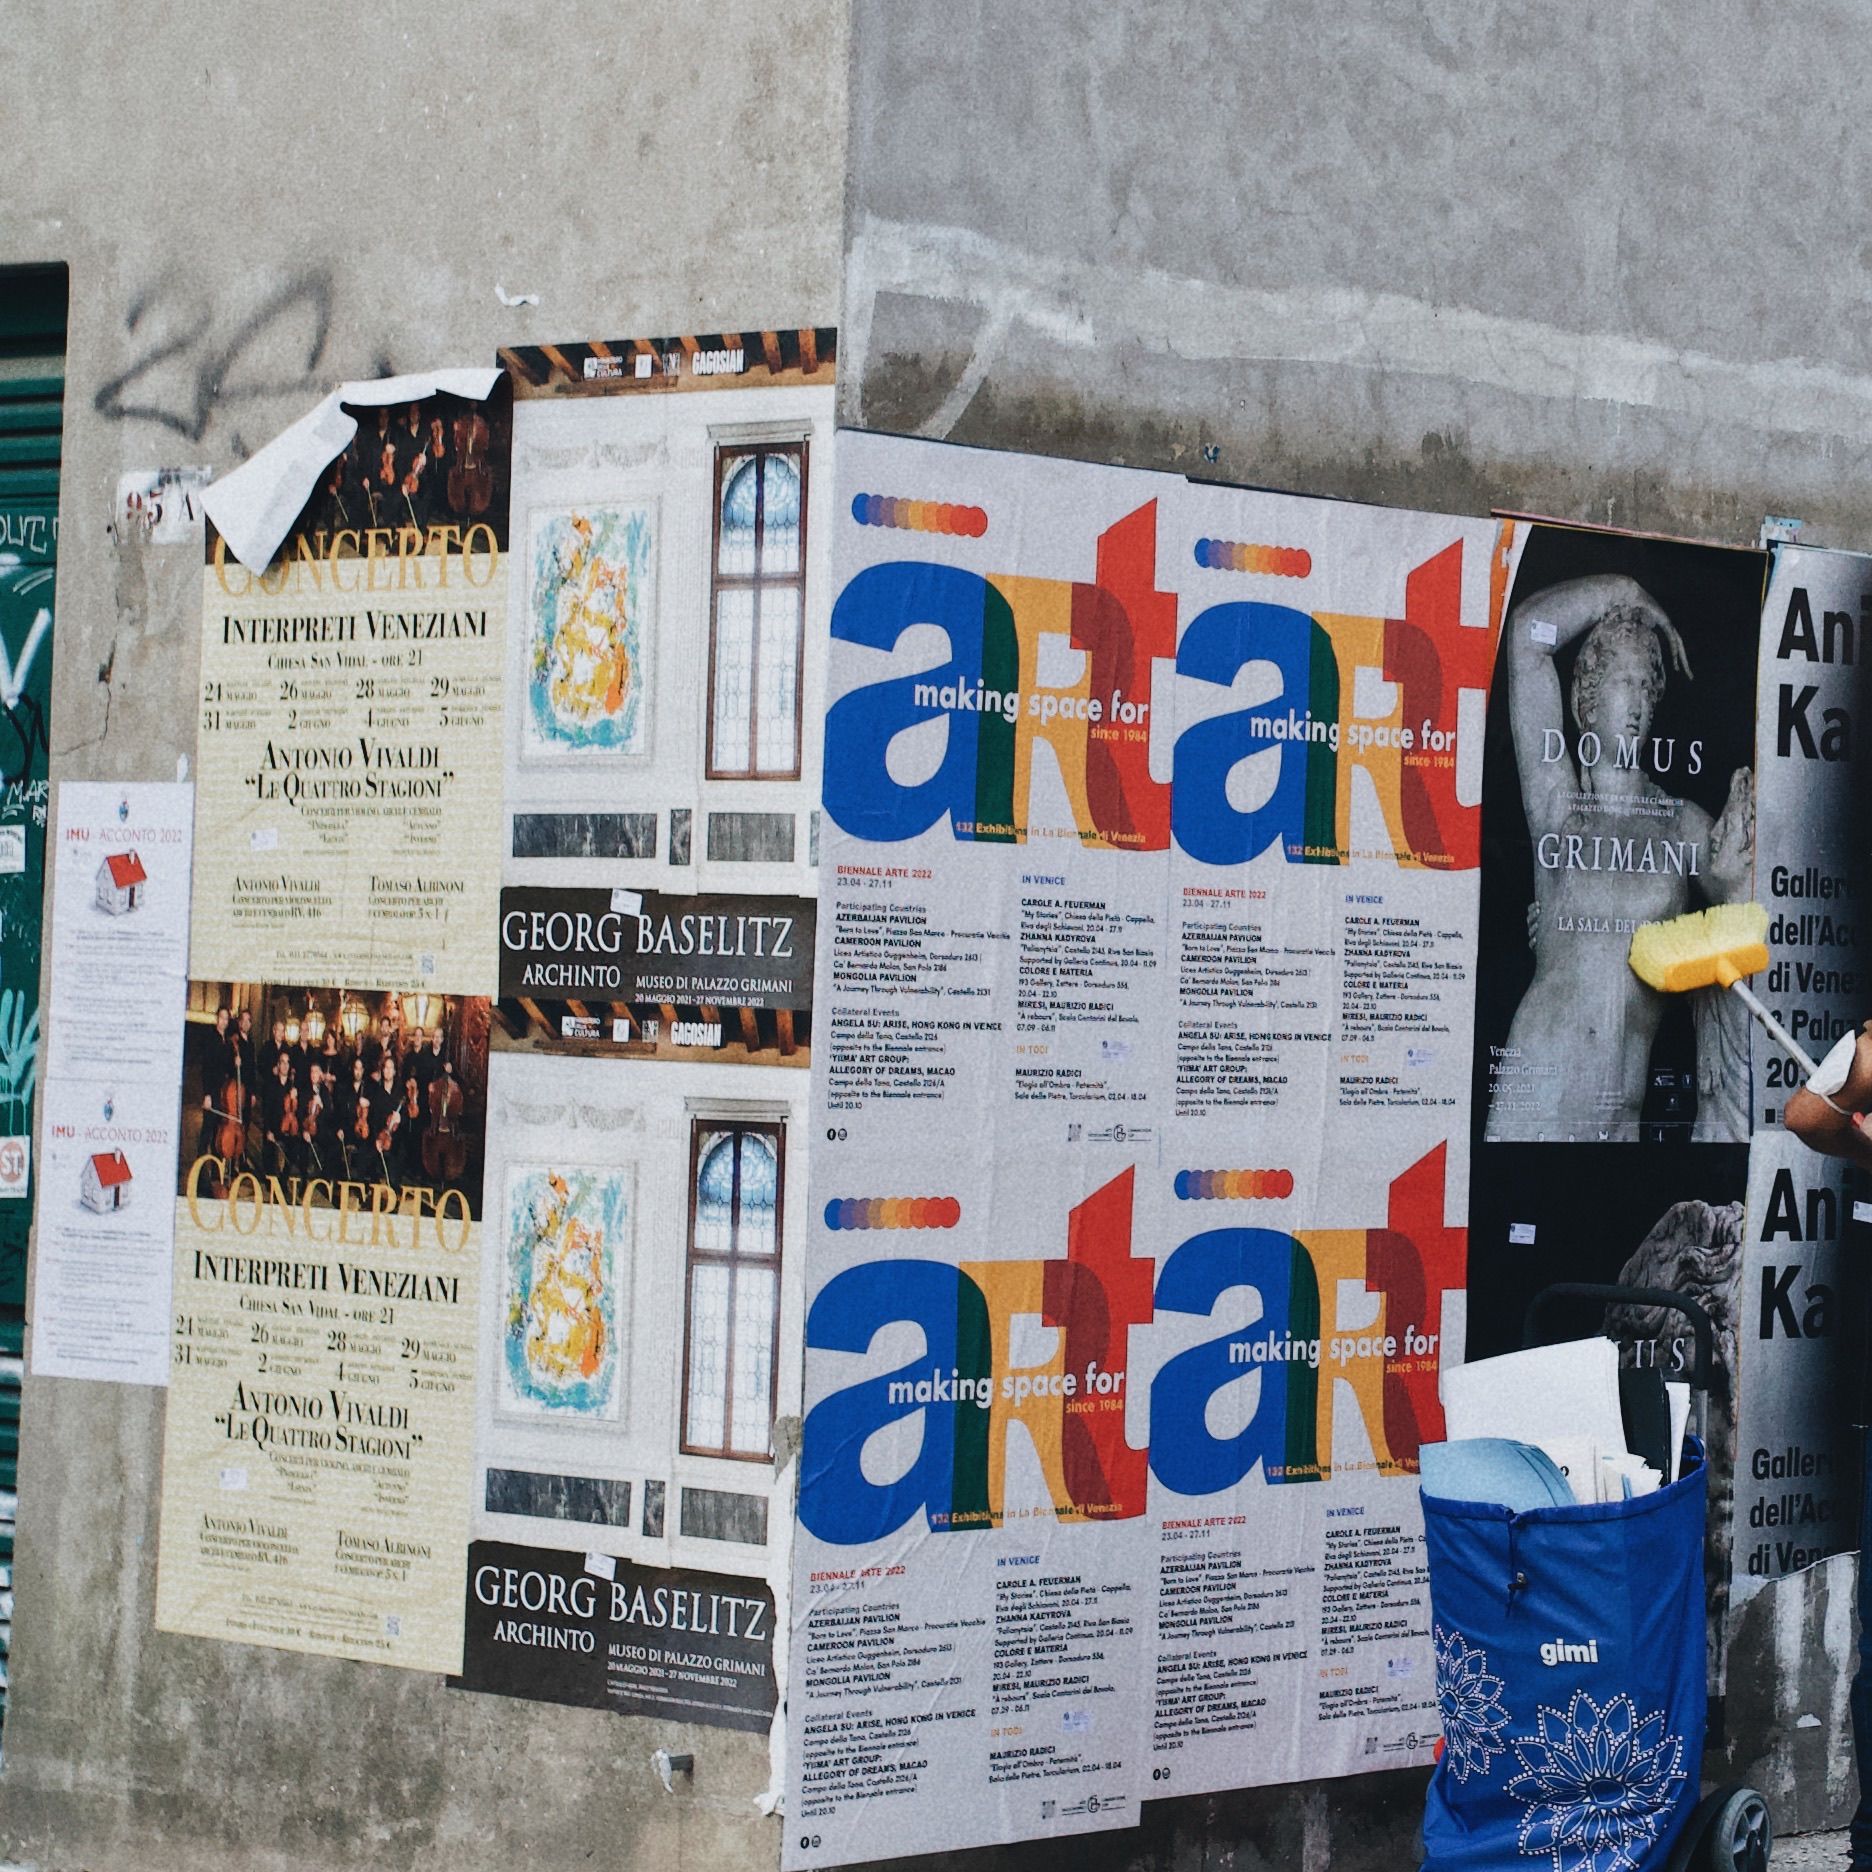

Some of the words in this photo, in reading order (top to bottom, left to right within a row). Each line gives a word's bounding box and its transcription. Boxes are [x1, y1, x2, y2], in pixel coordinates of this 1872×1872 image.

[692, 349, 744, 375] GAGOSIAN
[224, 616, 355, 643] INTERPRETI
[367, 611, 486, 639] VENEZIANI
[268, 654, 305, 670] CHIESA
[311, 654, 331, 668] SAN
[408, 649, 423, 666] 21
[279, 681, 298, 701] 26
[356, 679, 375, 699] 28
[430, 677, 449, 697] 29
[915, 676, 1019, 723] making
[1028, 695, 1102, 725] space
[1111, 689, 1148, 724] for
[204, 711, 220, 730] 31
[1251, 709, 1339, 752] making
[1348, 724, 1413, 754] space
[1421, 720, 1455, 751] for
[1123, 730, 1146, 742] 1984
[261, 740, 352, 770] ANTONIO
[359, 737, 439, 768] VIVALDI
[1434, 756, 1454, 768] 1984
[1541, 728, 1703, 775] DOMUS
[283, 771, 360, 806] QUATTRO
[66, 830, 90, 841] IMU
[100, 830, 156, 842] ACCONTO
[161, 830, 182, 842] 2022
[1538, 833, 1700, 876] GRIMANI
[234, 876, 278, 892] ANTONIO
[369, 876, 411, 892] TOMASO
[837, 866, 882, 876] BIENNALE
[886, 868, 908, 877] ARTE
[912, 870, 932, 878] 2022
[502, 911, 622, 953] GEORG
[636, 914, 793, 957] BASELITZ
[1558, 917, 1574, 931] LA
[1578, 918, 1610, 932] SALA
[884, 938, 921, 948] PAVILION
[522, 963, 620, 987] ARCHINTO
[636, 976, 673, 989] MUSEO
[676, 977, 688, 989] DI
[692, 977, 738, 991] PALAZZO
[741, 979, 792, 993] GRIMANI
[880, 973, 917, 982] PAVILION
[1769, 962, 1790, 993] di
[671, 1021, 721, 1046] GAGOSIAN
[52, 1126, 75, 1138] IMU
[84, 1128, 141, 1142] ACCONTO
[146, 1131, 168, 1143] 2022
[187, 1154, 471, 1253] CONCERTO
[195, 1250, 327, 1291] INTERPRETI
[338, 1263, 459, 1303] VENEZIANI
[240, 1297, 277, 1313] CHIESA
[282, 1298, 303, 1315] SAN
[380, 1308, 394, 1324] 21
[1229, 1330, 1321, 1368] making
[1330, 1333, 1397, 1367] space
[1404, 1326, 1438, 1356] for
[1416, 1360, 1436, 1372] 1984
[888, 1368, 992, 1408] making
[1002, 1372, 1077, 1408] space
[1085, 1361, 1124, 1395] for
[230, 1380, 322, 1420] ANTONIO
[331, 1390, 408, 1429] VIVALDI
[1100, 1399, 1123, 1412] 1984
[252, 1417, 331, 1450] QUATTRO
[1749, 1544, 1770, 1575] di
[475, 1565, 596, 1618] GEORG
[609, 1582, 767, 1641] BASELITZ
[493, 1620, 595, 1653] ARCHINTO
[608, 1644, 645, 1661] MUSEO
[649, 1649, 662, 1662] DI
[665, 1650, 712, 1669] PALAZZO
[714, 1658, 765, 1676] GRIMANI
[1540, 1638, 1598, 1666] gimi
